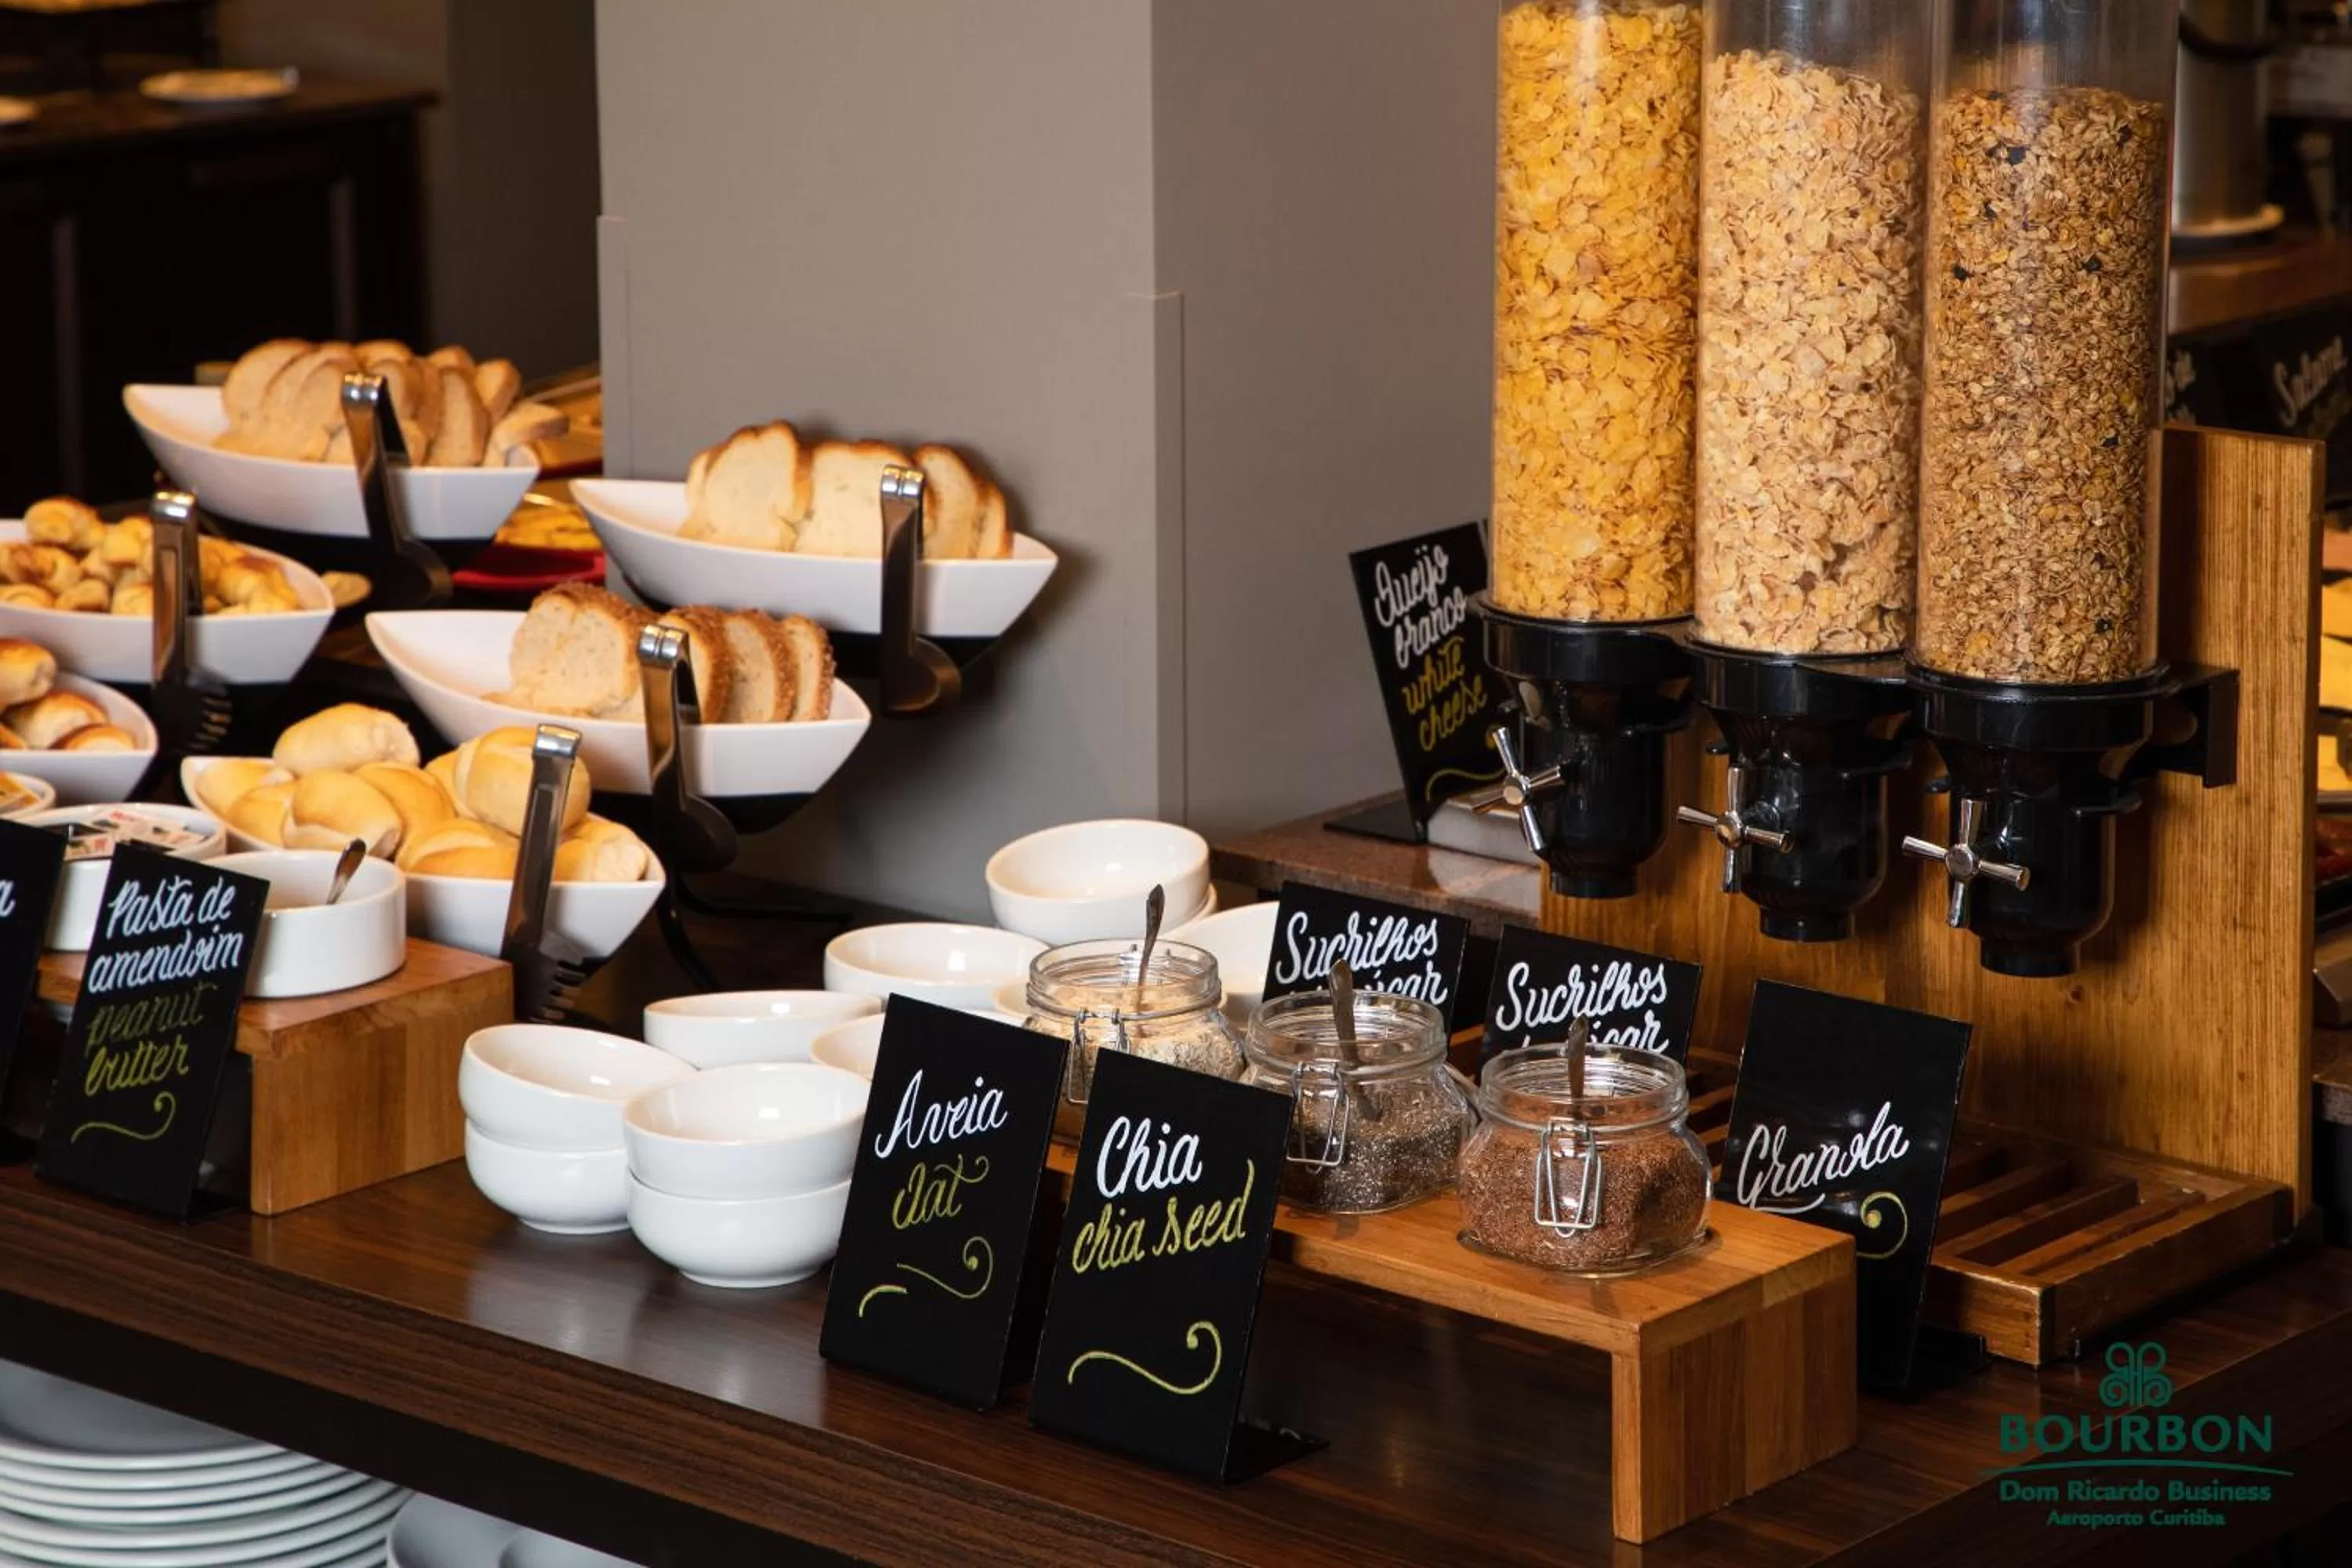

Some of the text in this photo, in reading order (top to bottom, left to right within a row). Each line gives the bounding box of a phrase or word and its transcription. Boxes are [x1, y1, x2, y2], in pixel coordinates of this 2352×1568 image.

[1374, 544, 1449, 628] Queijo
[1395, 586, 1467, 669] branco
[1403, 636, 1465, 714] white
[1420, 675, 1487, 751] cheese
[106, 874, 236, 939] Pasta de
[89, 925, 244, 993] amendoim
[1276, 911, 1438, 985] Sucrilhos
[85, 980, 219, 1056] peanut
[1496, 960, 1667, 1031] Sucrilhos
[85, 1034, 190, 1095] butter
[875, 1069, 1008, 1159] Aveia
[892, 1153, 990, 1229] Oat
[1098, 1116, 1203, 1199] Chia
[1737, 1102, 1911, 1214] Granola
[1073, 1158, 1254, 1275] chia seed
